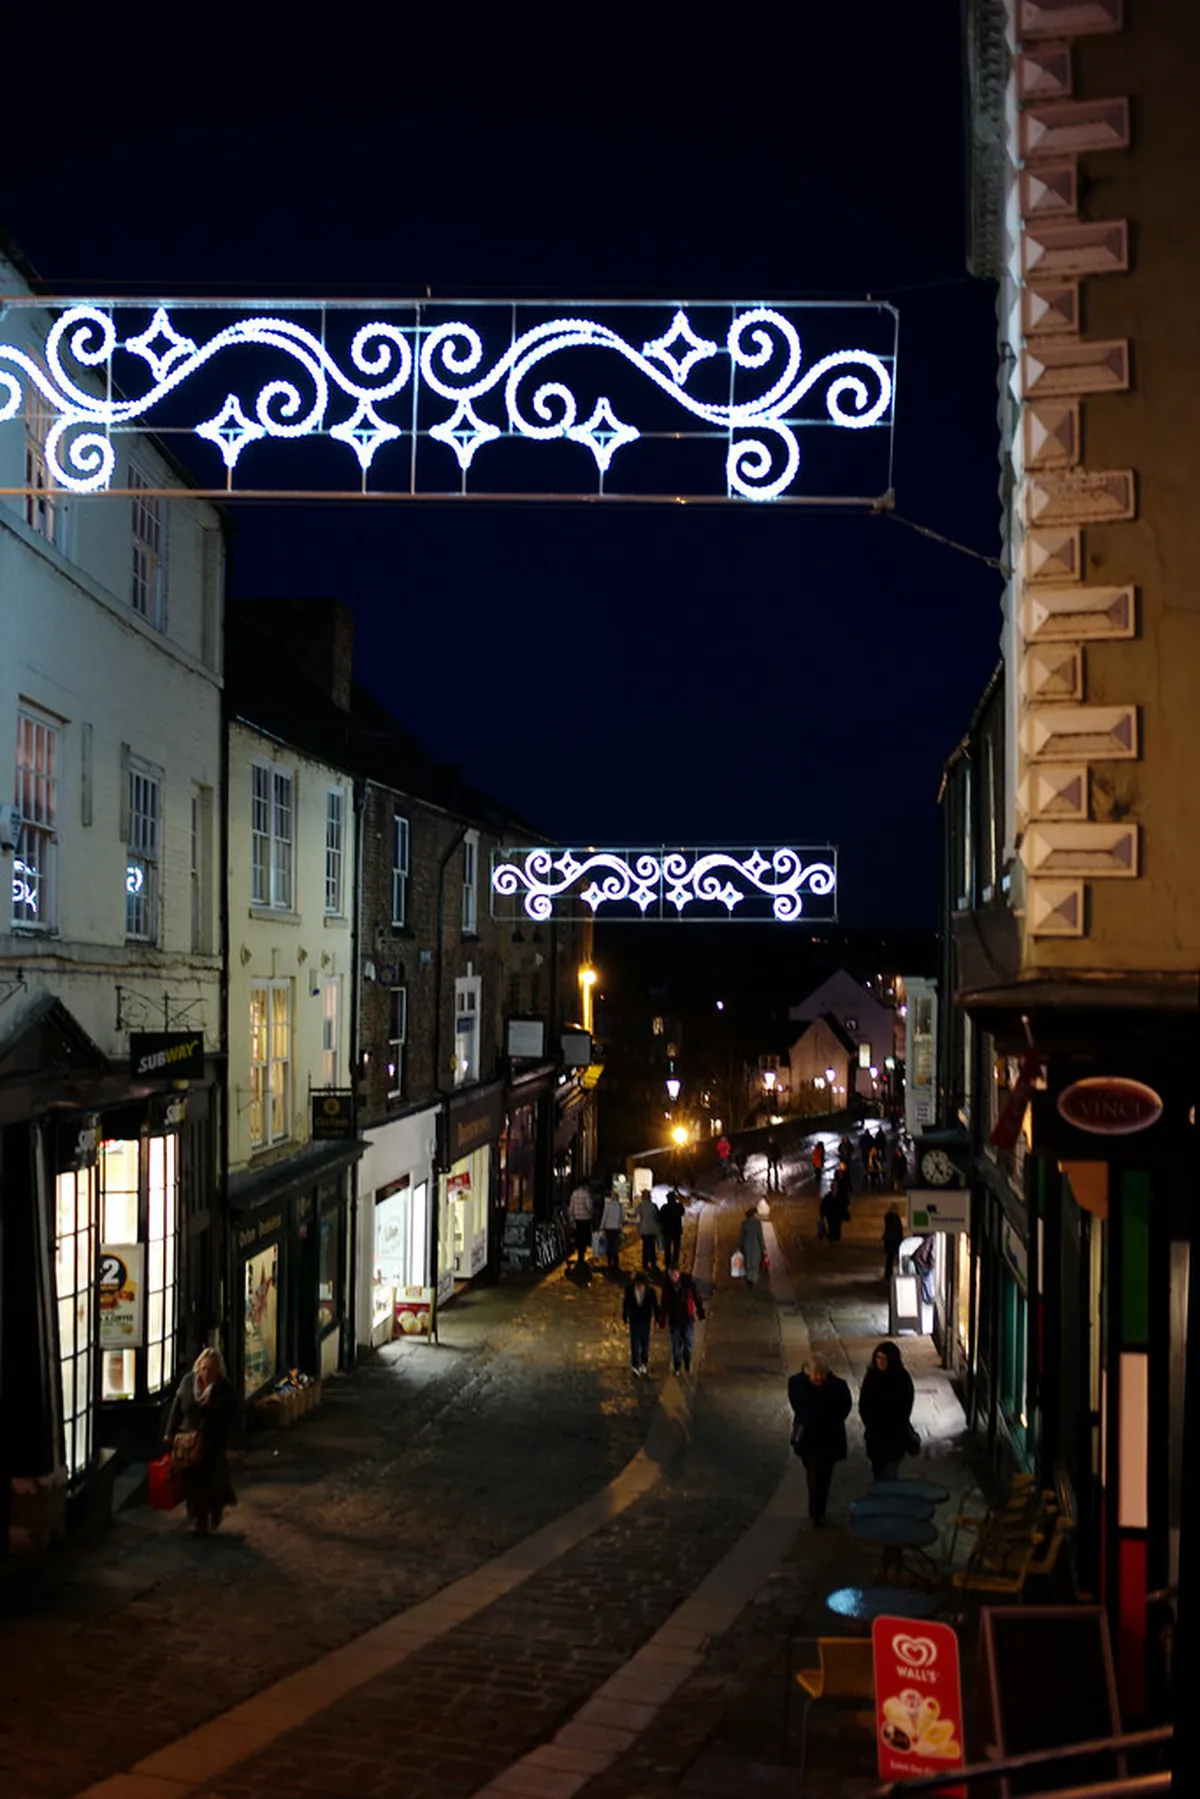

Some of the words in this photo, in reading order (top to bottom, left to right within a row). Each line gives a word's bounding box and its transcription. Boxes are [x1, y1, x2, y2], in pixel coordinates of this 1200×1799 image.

[137, 1040, 200, 1074] SUBWAY
[1079, 1099, 1141, 1118] VINCI
[896, 1664, 937, 1684] WALL'S
